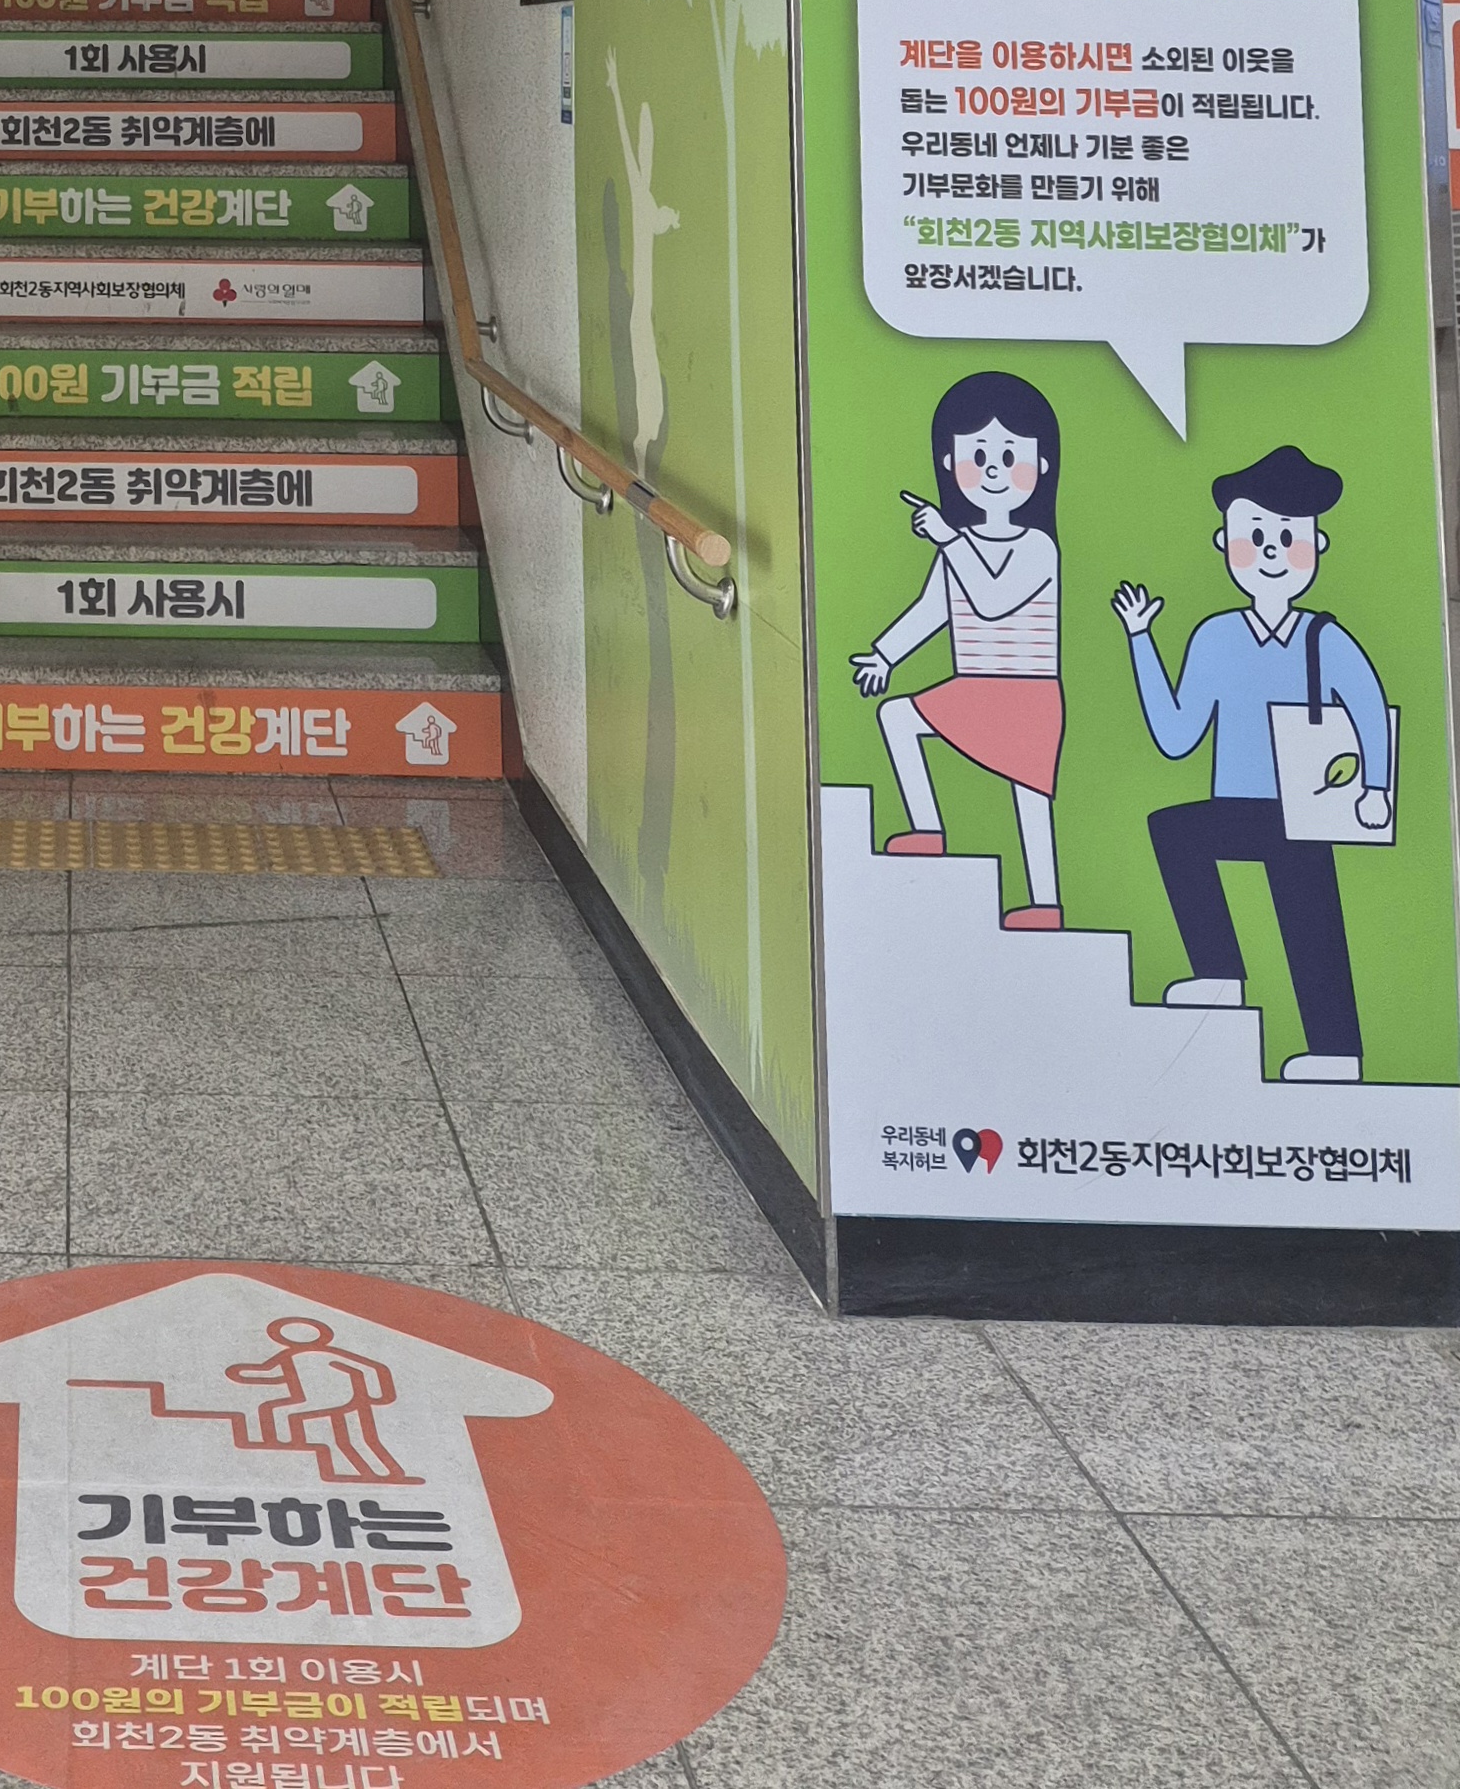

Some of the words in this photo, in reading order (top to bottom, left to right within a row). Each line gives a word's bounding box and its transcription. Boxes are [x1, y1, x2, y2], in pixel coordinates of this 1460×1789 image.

[64, 44, 109, 73] 1회
[117, 43, 207, 74] 사용시
[899, 39, 983, 70] 계단을
[992, 40, 1133, 72] 이용하시면
[1141, 46, 1215, 73] 소외된
[1222, 46, 1295, 74] 이웃을
[900, 88, 948, 115] 돕는
[954, 86, 1066, 116] 100원의
[1075, 88, 1185, 119] 기부금이
[1191, 93, 1321, 121] 적립됩니다.
[0, 115, 112, 147] 회천2동
[120, 115, 276, 148] 취약계층에
[901, 131, 998, 159] 우리동네
[1004, 132, 1078, 160] 언제나
[1085, 133, 1134, 161] 기분
[1141, 134, 1190, 162] 좋은
[902, 172, 1023, 201] 기부문화를
[1030, 174, 1104, 202] 만들기
[1111, 176, 1161, 203] 위해
[142, 188, 292, 227] 건강계단
[903, 264, 1084, 293] 앞장서겠습니다.
[101, 364, 221, 406] 기부금
[232, 364, 313, 407] 적립
[126, 467, 313, 509] 취약계층에
[56, 578, 116, 618] 1회
[126, 578, 245, 620] 사용시
[160, 705, 351, 757] 건강계단
[881, 1125, 947, 1148] 우리동네
[881, 1150, 948, 1173] 복지허브
[1017, 1136, 1413, 1184] 회천2동지역사회보장협의체
[77, 1493, 454, 1552] 기부하는
[79, 1555, 472, 1619] 건강계단
[130, 1652, 213, 1681] 계단
[225, 1656, 287, 1684] 1회
[300, 1657, 424, 1687] 이용시
[15, 1685, 185, 1716] 100원의
[197, 1688, 368, 1720] 기부금이
[378, 1692, 551, 1725] 적립되며
[71, 1721, 229, 1754] 회천2동
[240, 1725, 503, 1760] 취약계층에서
